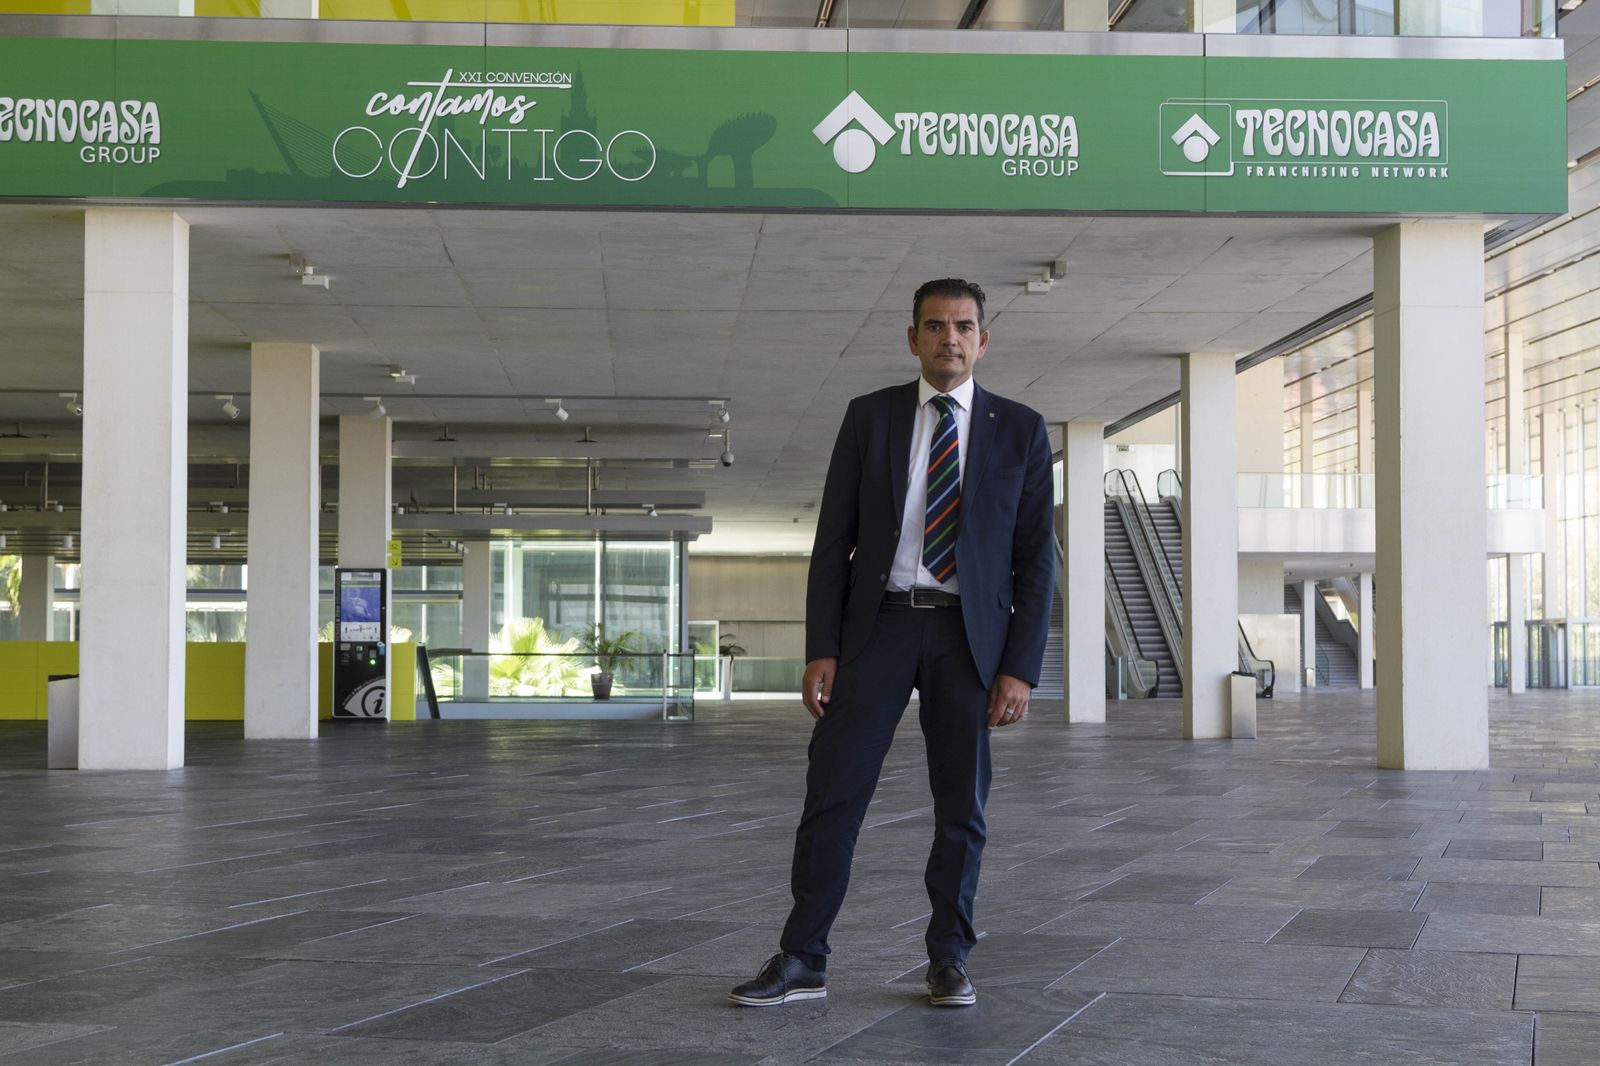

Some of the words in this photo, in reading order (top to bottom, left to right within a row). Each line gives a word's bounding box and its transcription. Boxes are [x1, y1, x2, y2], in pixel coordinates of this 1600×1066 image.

[459, 72, 482, 82] XXI
[485, 71, 572, 83] CONVENCIÓN
[894, 111, 1079, 158] TECNOCASA
[1235, 108, 1440, 158] TECNOCASA
[80, 146, 161, 164] GROUP
[333, 126, 656, 182] CONTIGO
[1001, 159, 1079, 177] GROUP
[1246, 166, 1360, 178] FRANCHISING
[1371, 166, 1450, 179] NETWORK
